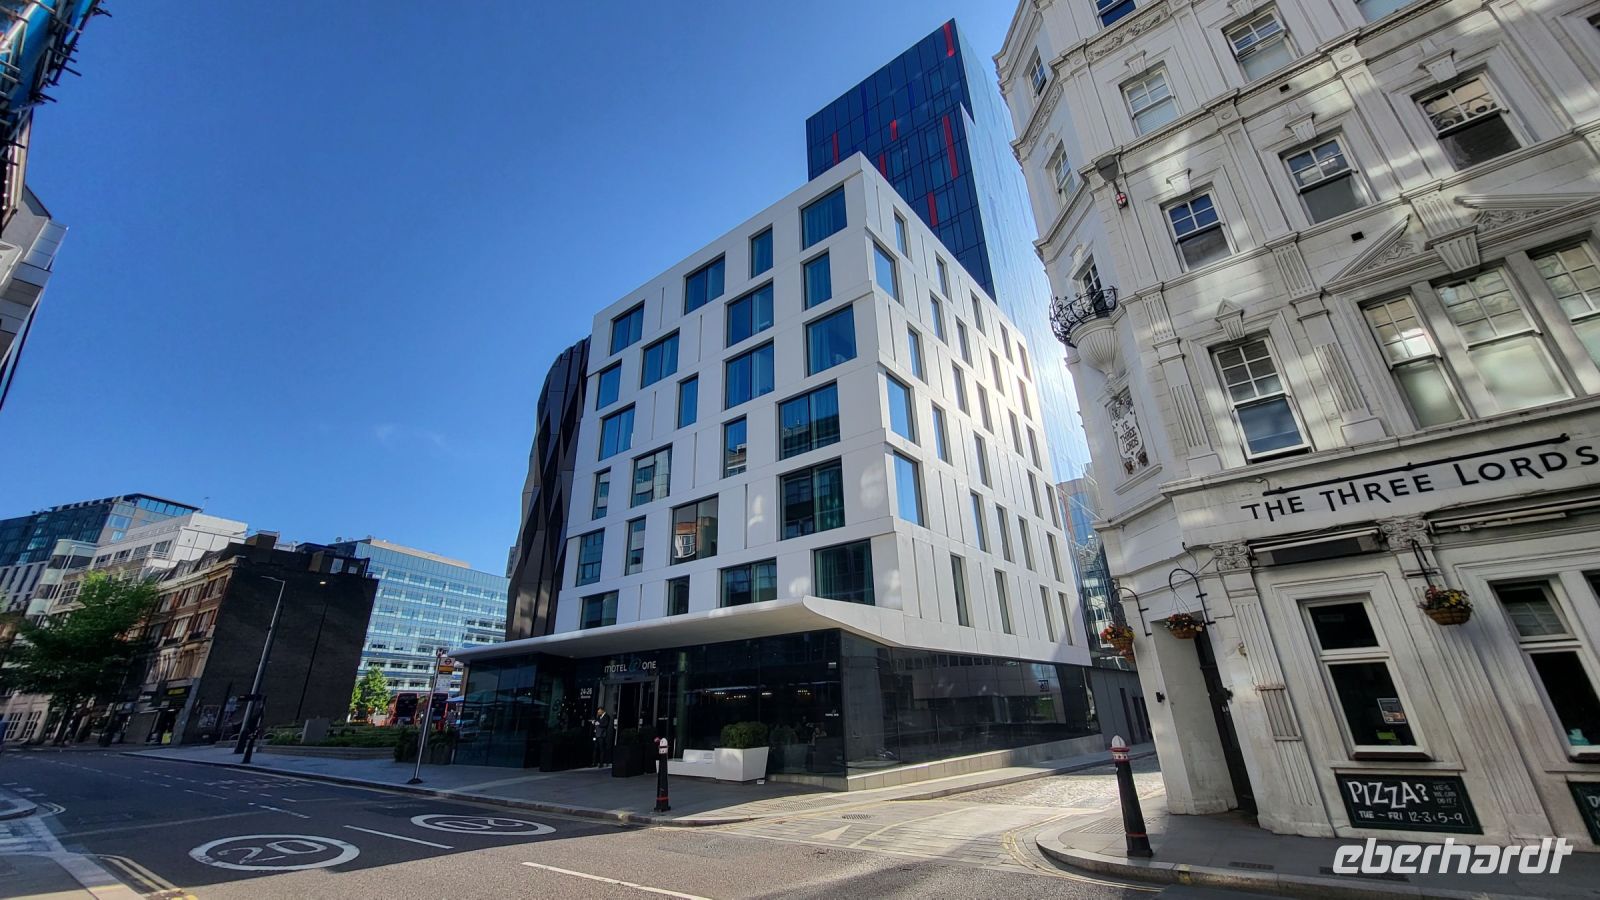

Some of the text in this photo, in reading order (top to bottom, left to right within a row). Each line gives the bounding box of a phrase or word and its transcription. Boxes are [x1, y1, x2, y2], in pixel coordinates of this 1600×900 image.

[1120, 420, 1130, 432] YE
[1120, 426, 1137, 445] THREE
[1123, 436, 1139, 454] LORDS
[1240, 445, 1600, 522] THE THREE LORDS
[604, 660, 657, 673] MOTEL ONE
[1347, 781, 1430, 809] PIZZA?
[1359, 810, 1375, 819] TUE
[1387, 811, 1403, 820] FRI
[217, 839, 328, 865] 20
